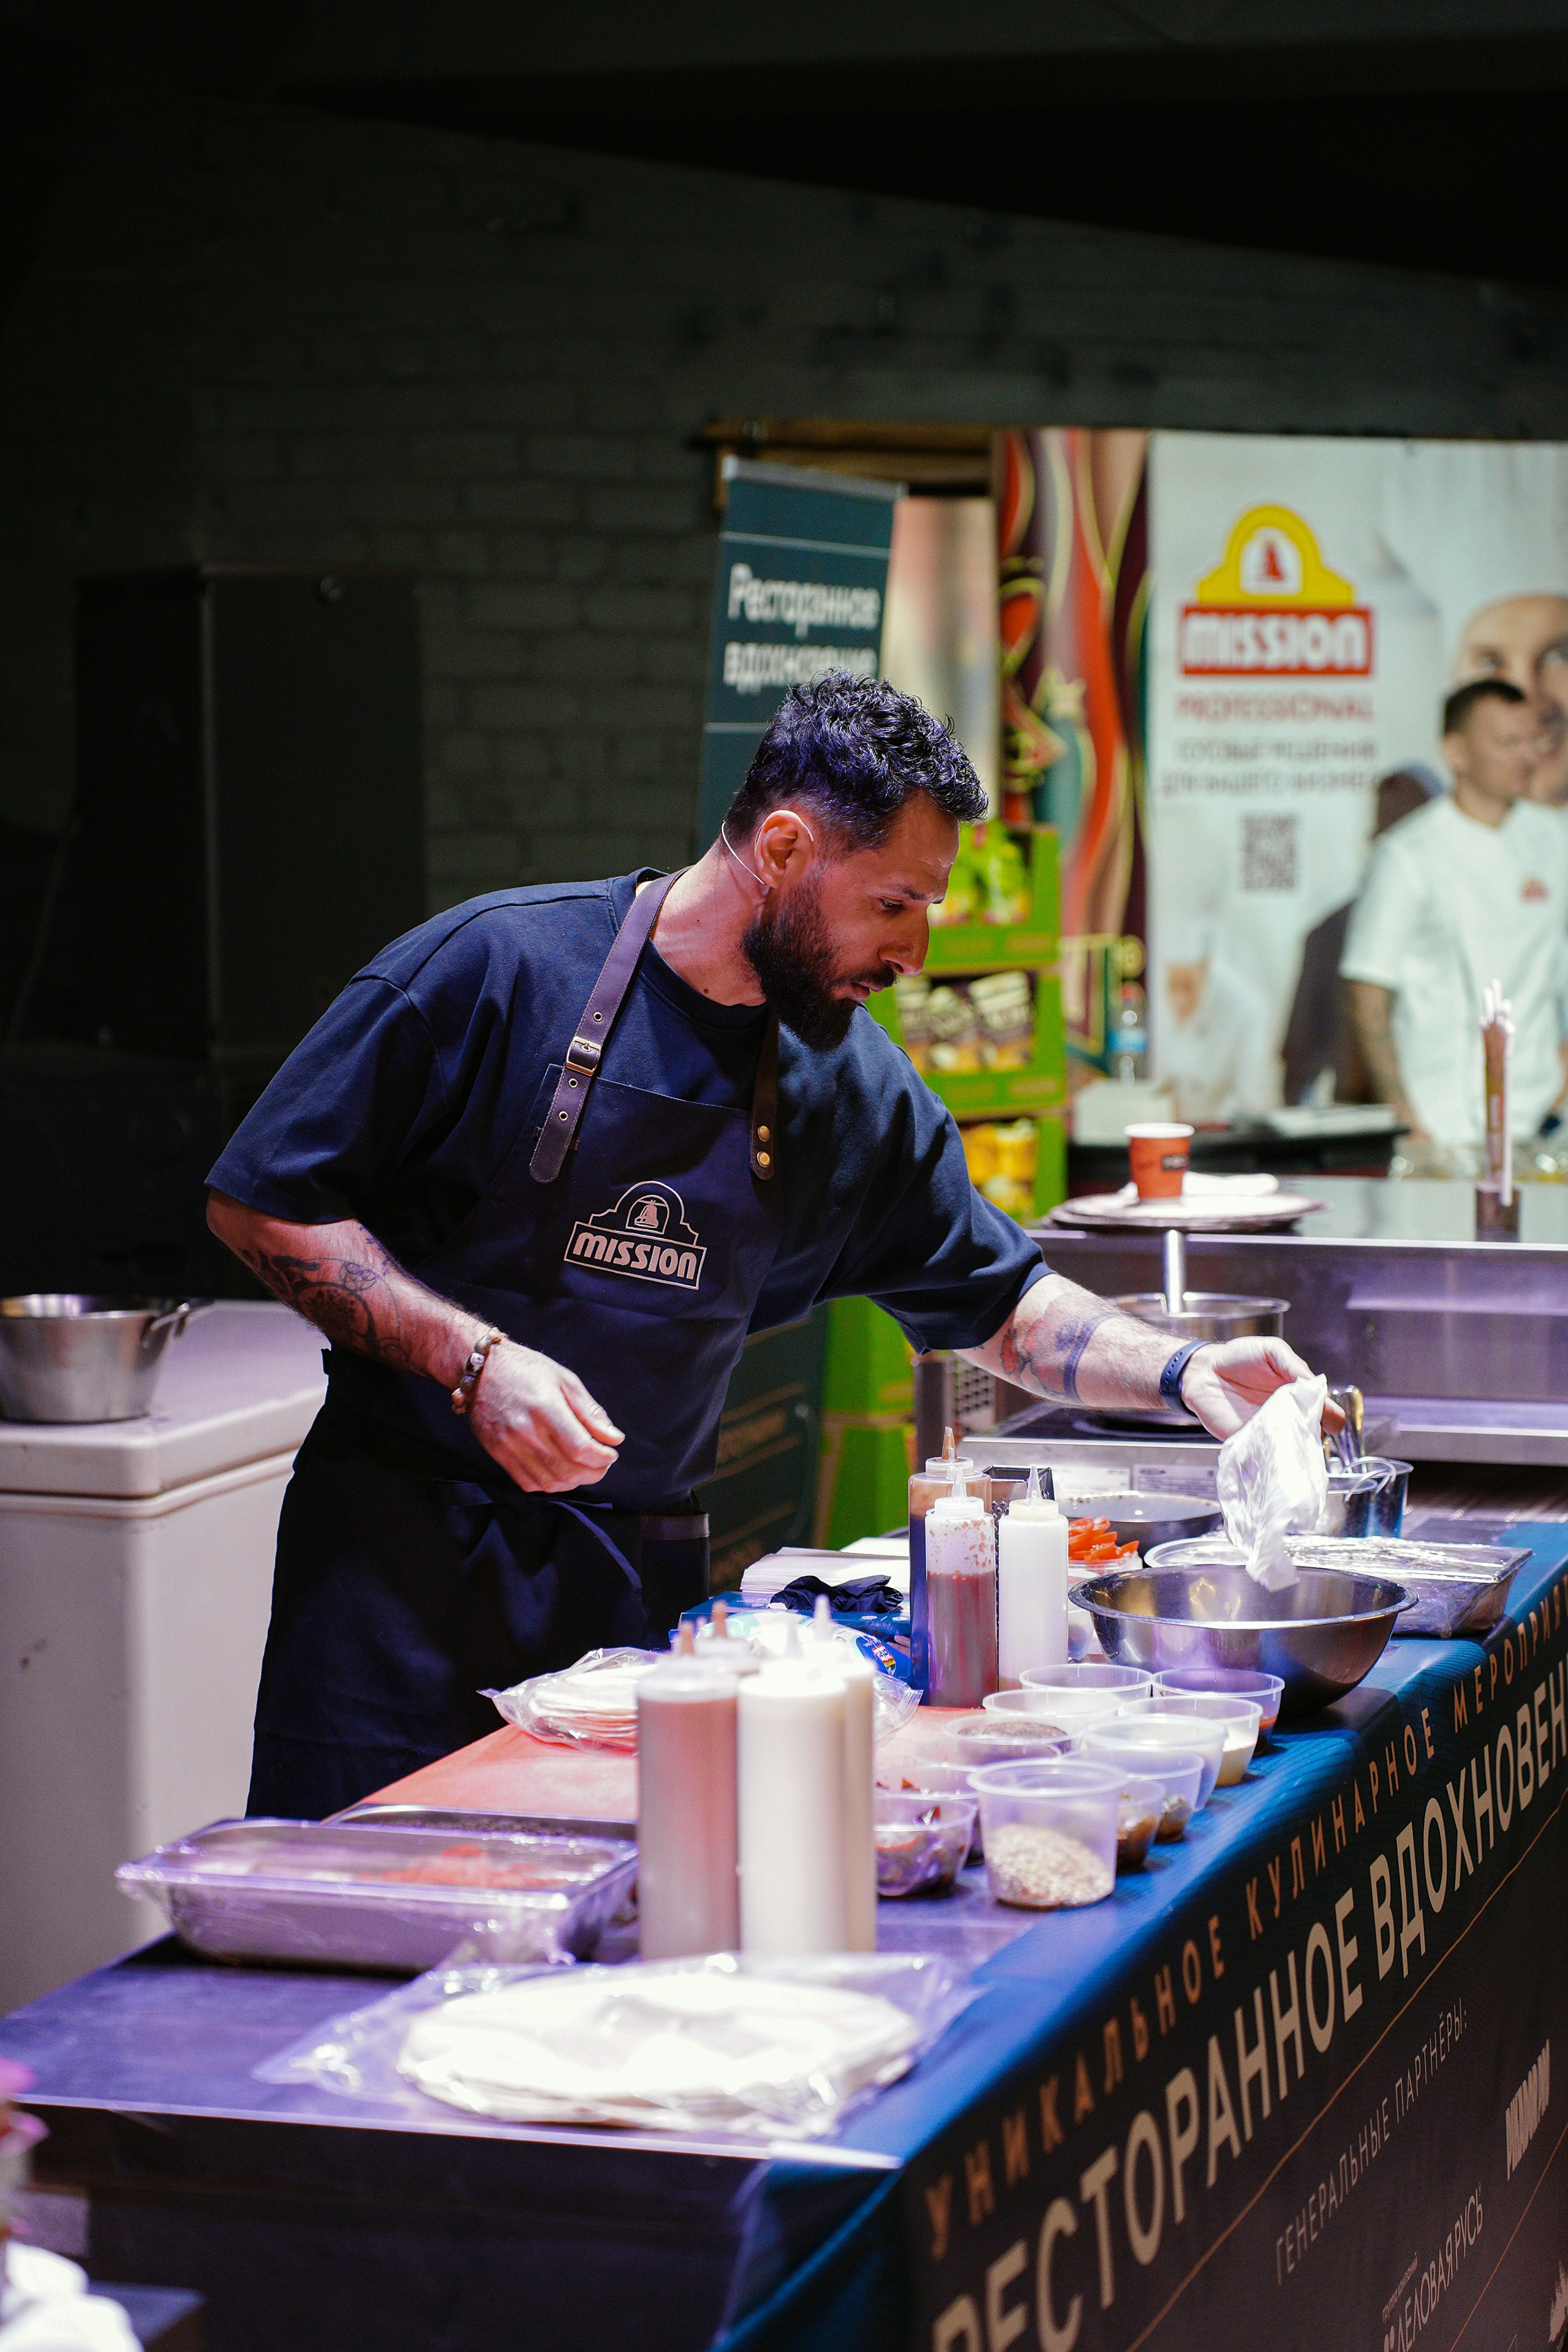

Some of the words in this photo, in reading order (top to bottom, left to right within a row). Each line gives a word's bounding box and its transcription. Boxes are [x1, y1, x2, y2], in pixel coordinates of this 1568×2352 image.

[572, 1232, 697, 1280] MISSION
[1369, 1652, 1568, 1981] ВДОХНОВЕН
[924, 1913, 1224, 2261] УНИКАЛЬНОЕ
[1245, 1706, 1434, 1941] КУЛИНАРНОЕ
[1277, 2097, 1390, 2286] ГЕНЕРАЛЬНЫЕ
[1395, 1997, 1468, 2124] ПАРТНЁРЫ:
